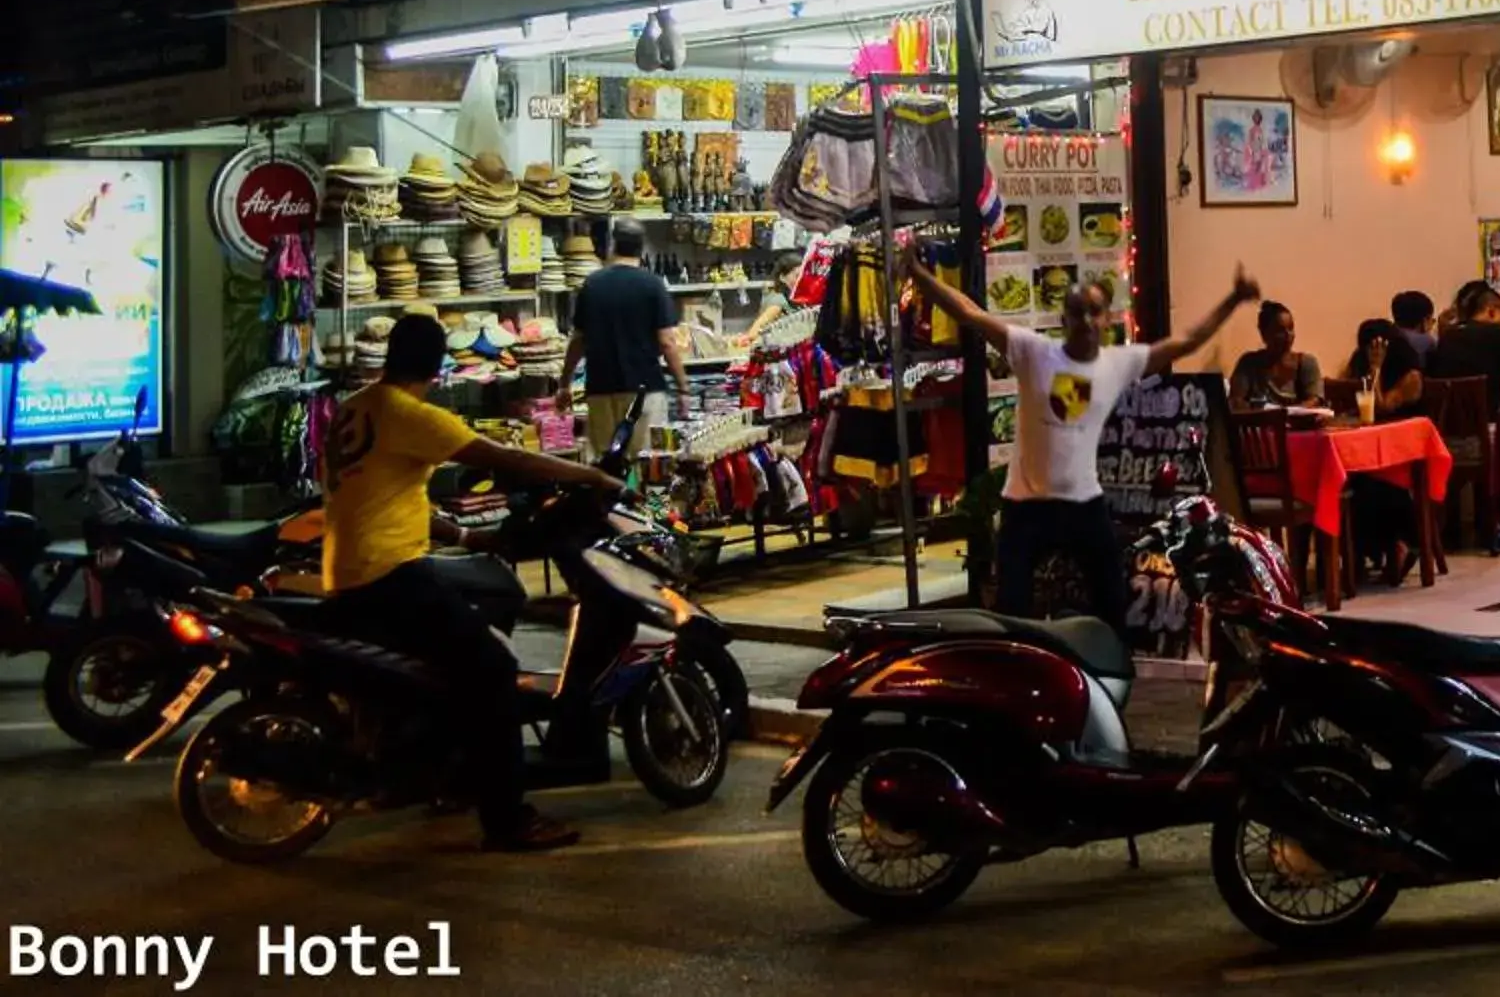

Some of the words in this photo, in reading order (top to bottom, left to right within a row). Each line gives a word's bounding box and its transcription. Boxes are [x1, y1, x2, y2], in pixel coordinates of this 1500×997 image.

[1144, 0, 1294, 46] CONTACT
[1003, 140, 1060, 168] CURRY
[1066, 141, 1098, 168] POT
